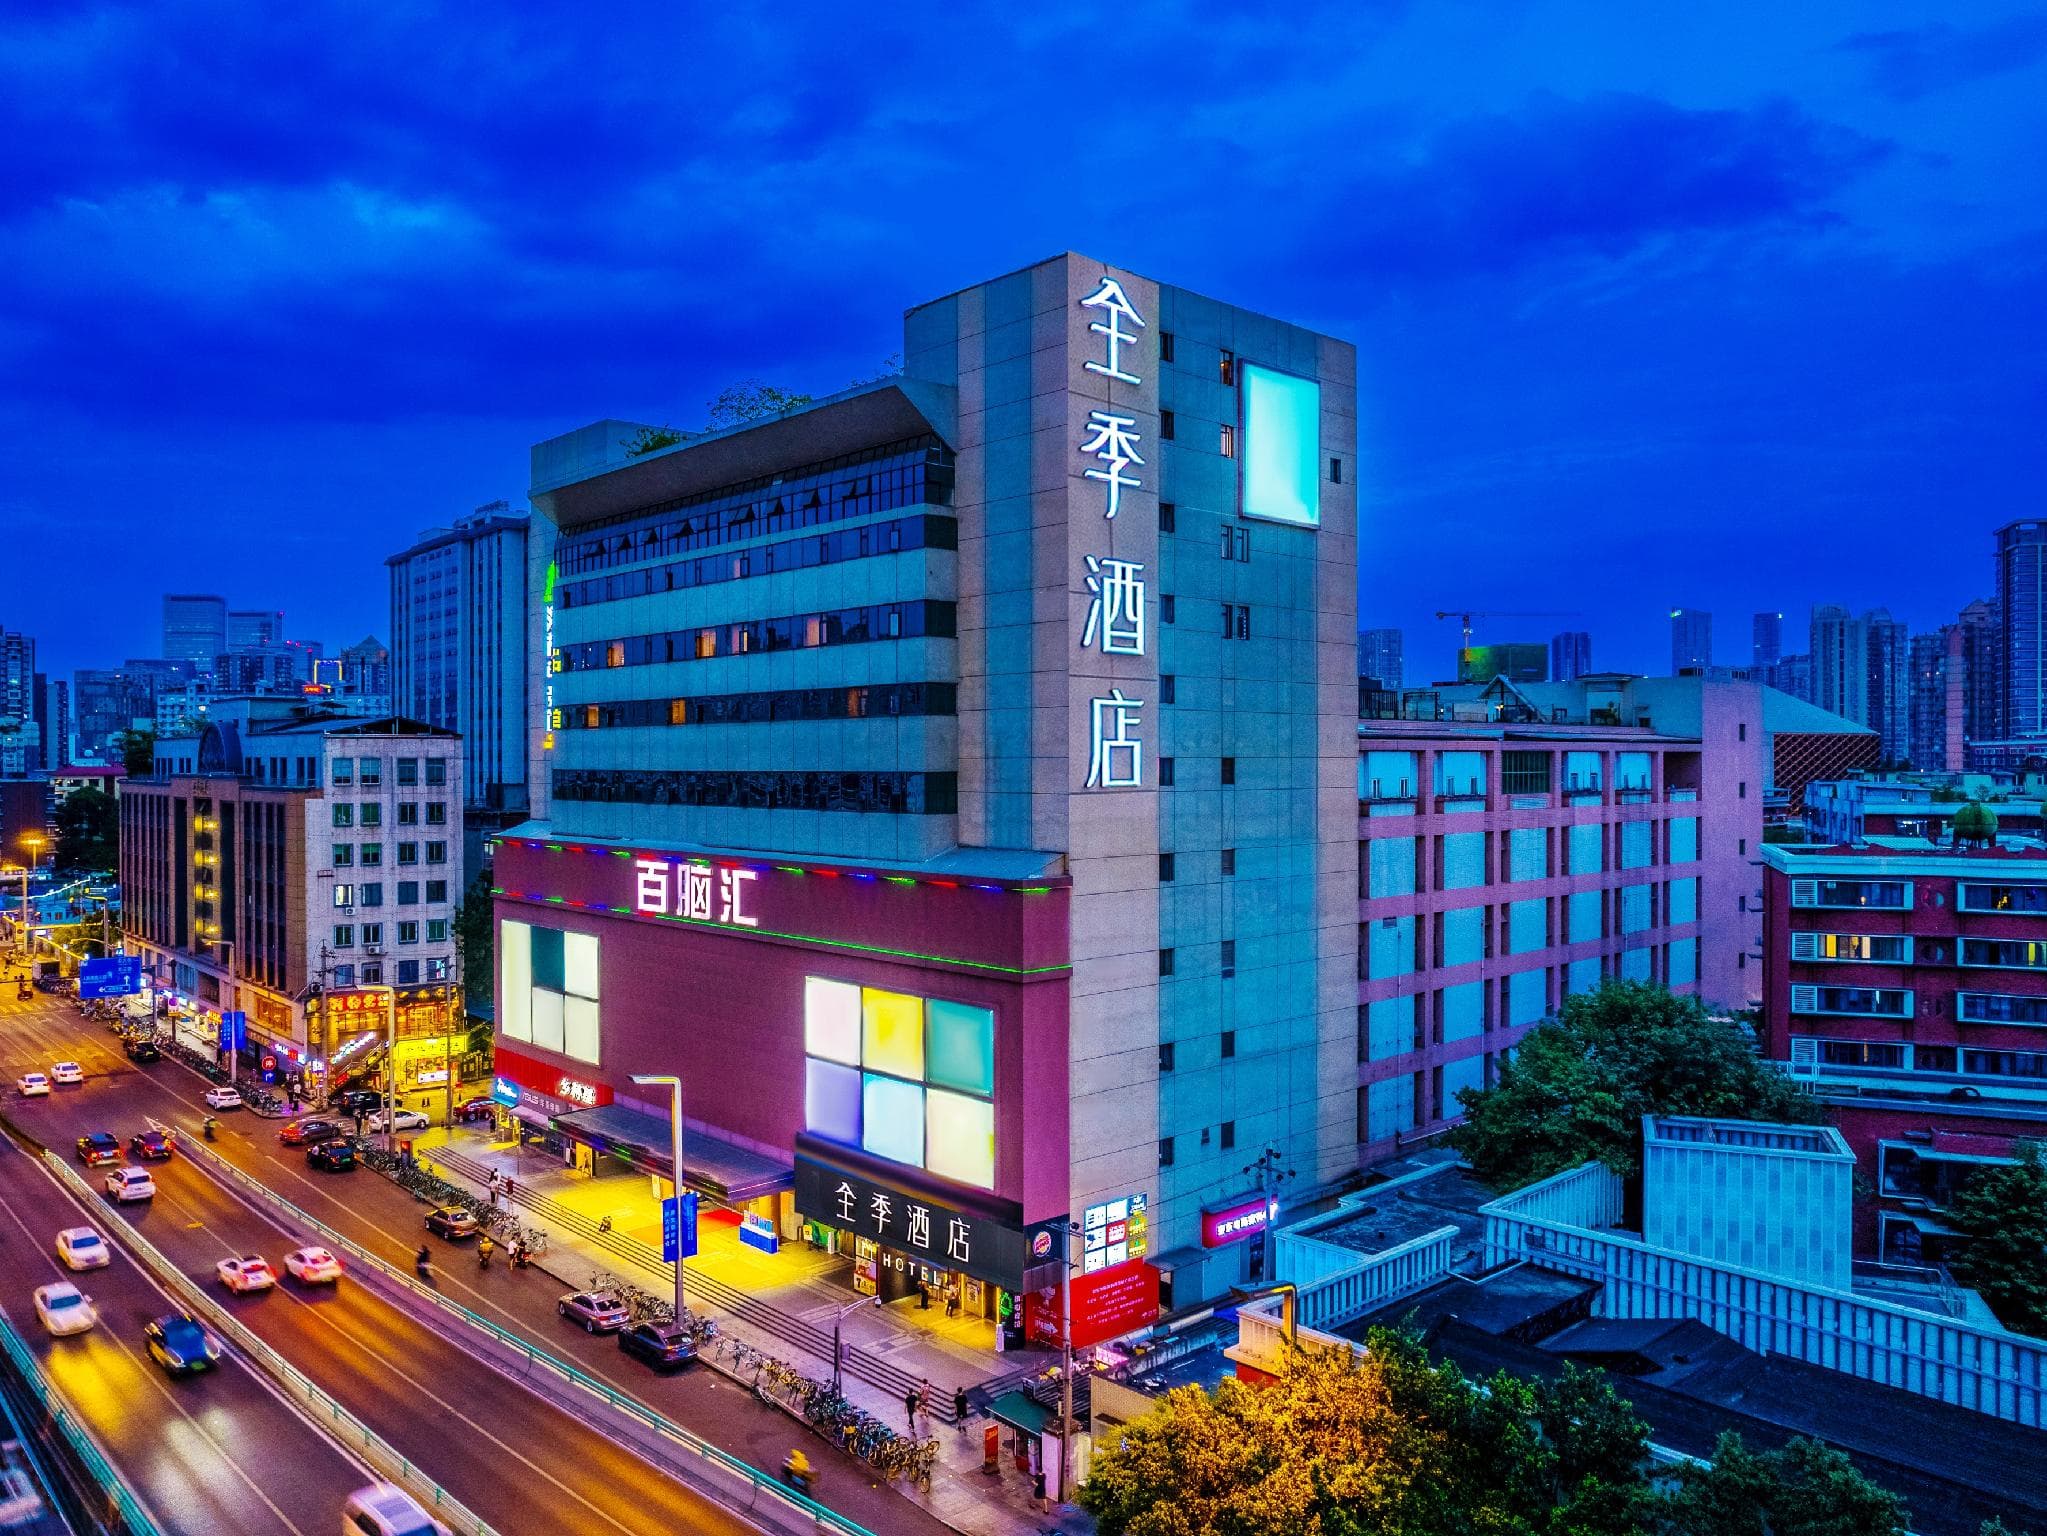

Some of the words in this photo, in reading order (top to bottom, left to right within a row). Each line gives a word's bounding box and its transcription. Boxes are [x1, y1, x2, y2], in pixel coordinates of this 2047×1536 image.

[1081, 278, 1146, 788] 全季酒店
[636, 859, 759, 927] 百脑汇
[835, 1181, 970, 1263] 全季酒店
[883, 1253, 942, 1287] HOTEL
